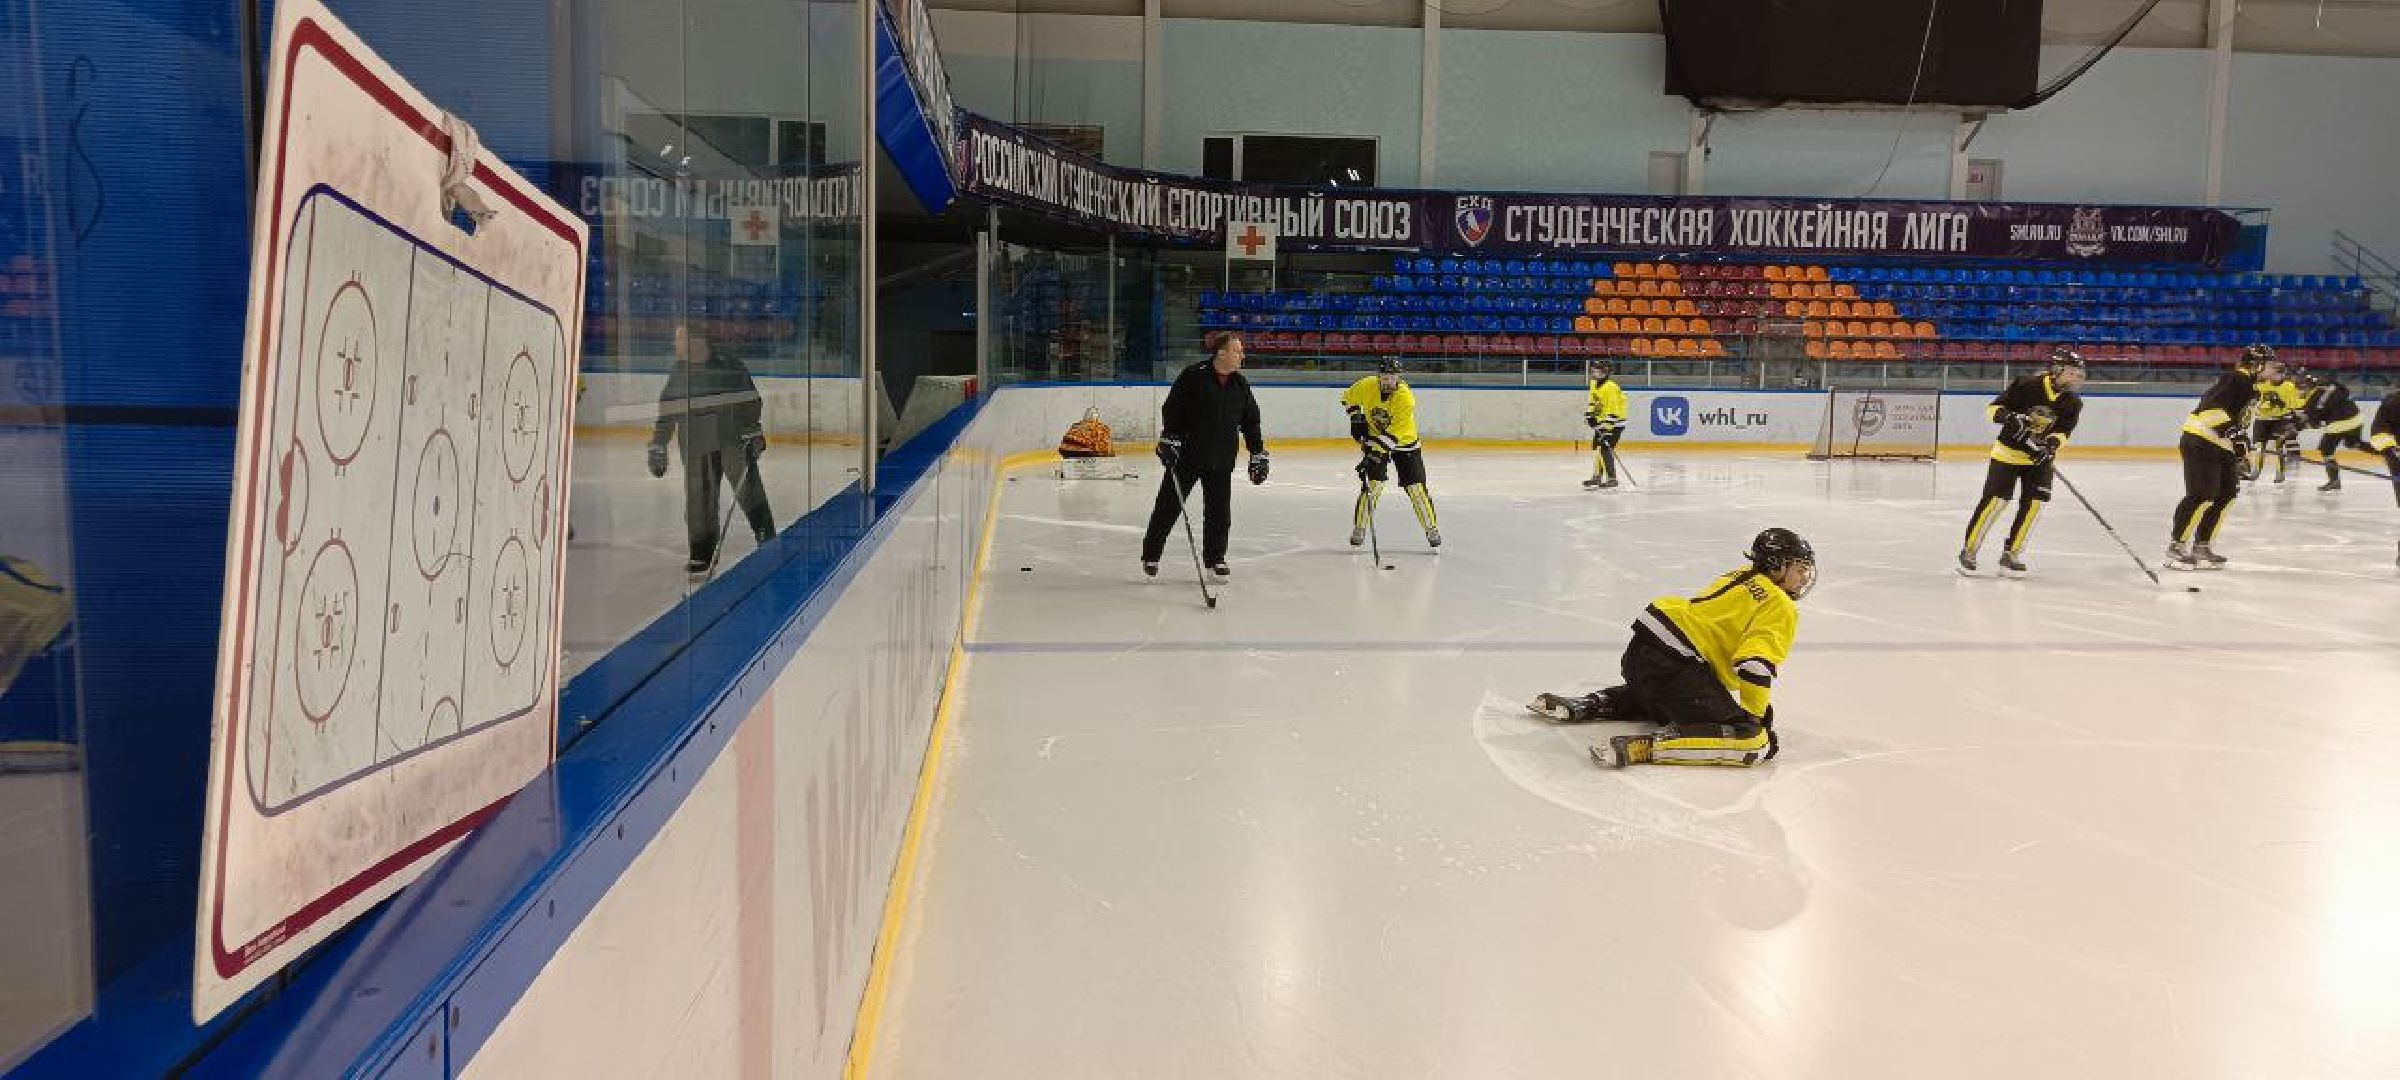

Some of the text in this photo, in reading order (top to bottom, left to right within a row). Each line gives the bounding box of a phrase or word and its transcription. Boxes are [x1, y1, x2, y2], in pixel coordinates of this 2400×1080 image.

[972, 129, 1411, 240] РОССИЙСКИЙ СТУДЕНЧЕСКИЙ СПОРТИВНЫЙ СОЮЗ
[1505, 203, 1969, 252] СТУДЕНЧЕСКАЯ ХОККЕЙНАЯ ЛИГА
[1698, 407, 1767, 430] whl_ru
